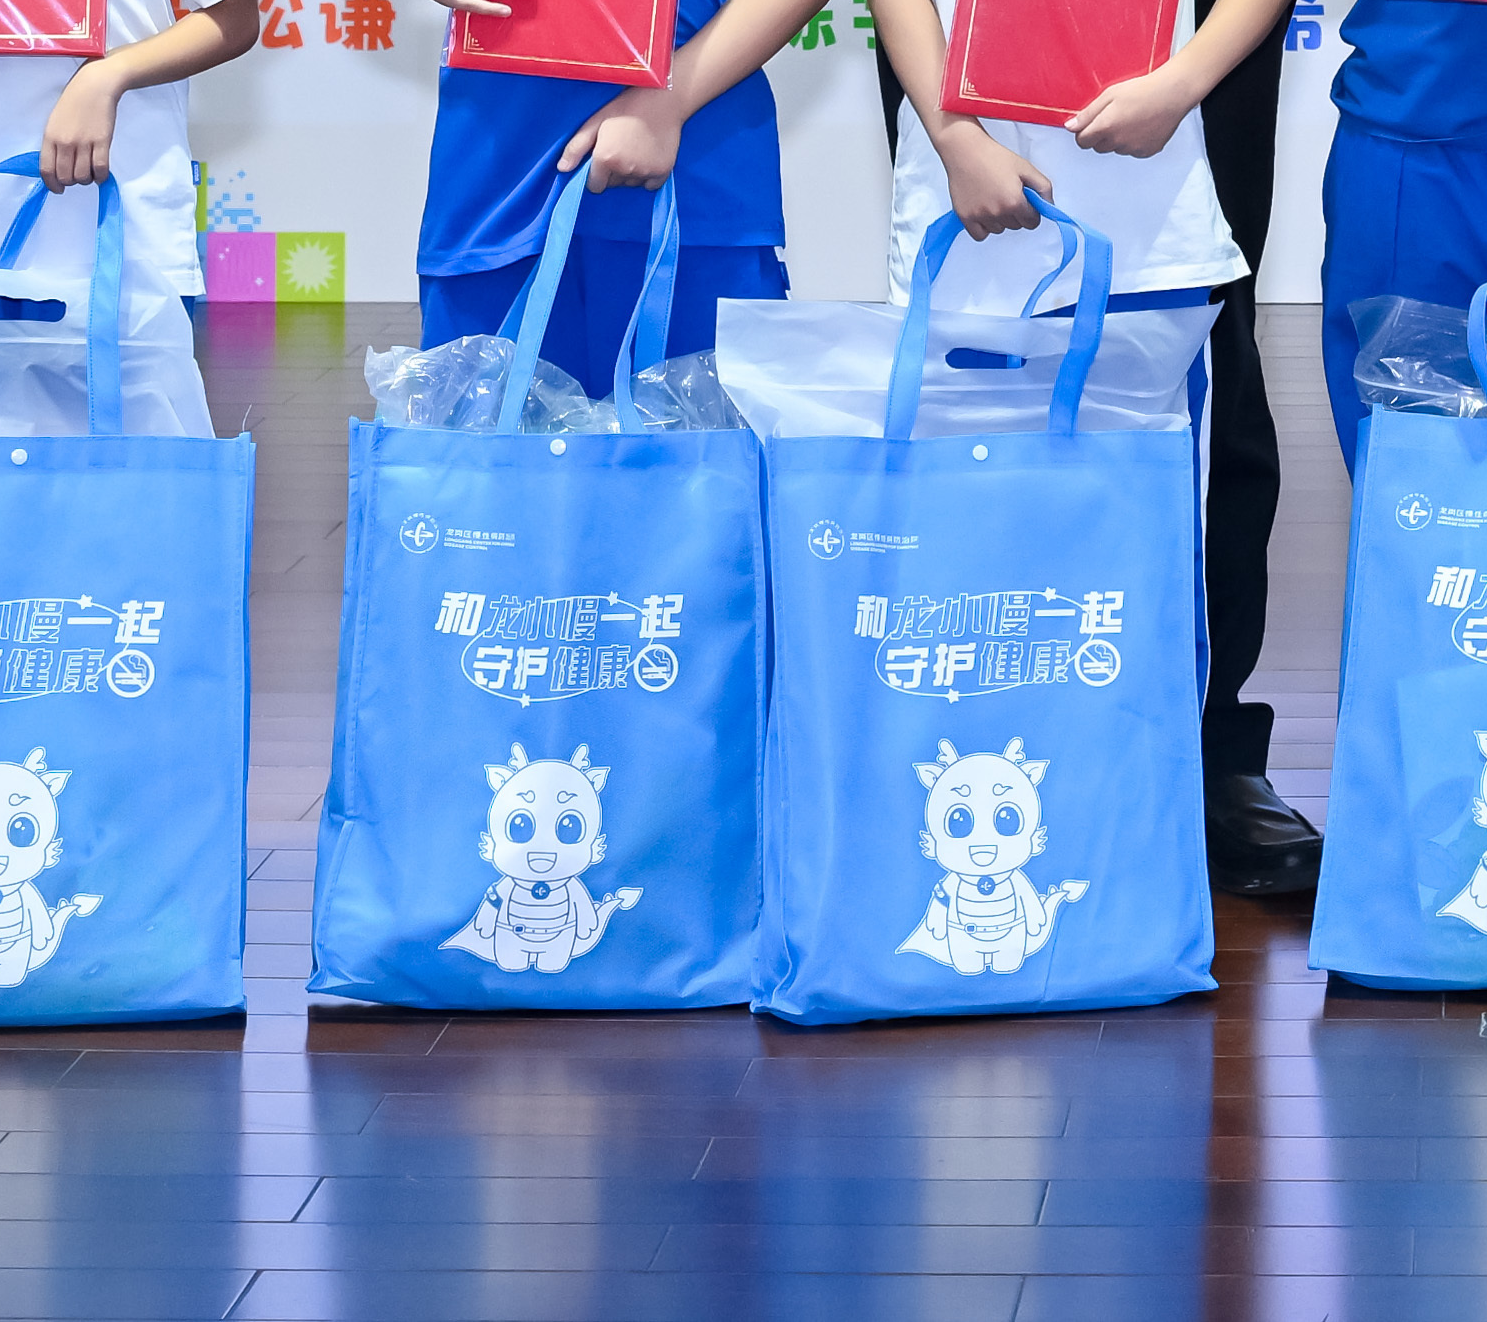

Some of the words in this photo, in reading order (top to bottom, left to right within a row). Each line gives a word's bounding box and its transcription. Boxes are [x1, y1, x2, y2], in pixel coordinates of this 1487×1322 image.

[435, 591, 684, 641] 和龙小慢一起
[854, 591, 1124, 640] 和龙小慢一起
[472, 645, 632, 691] 守护健康
[884, 639, 1071, 688] 守护健康
